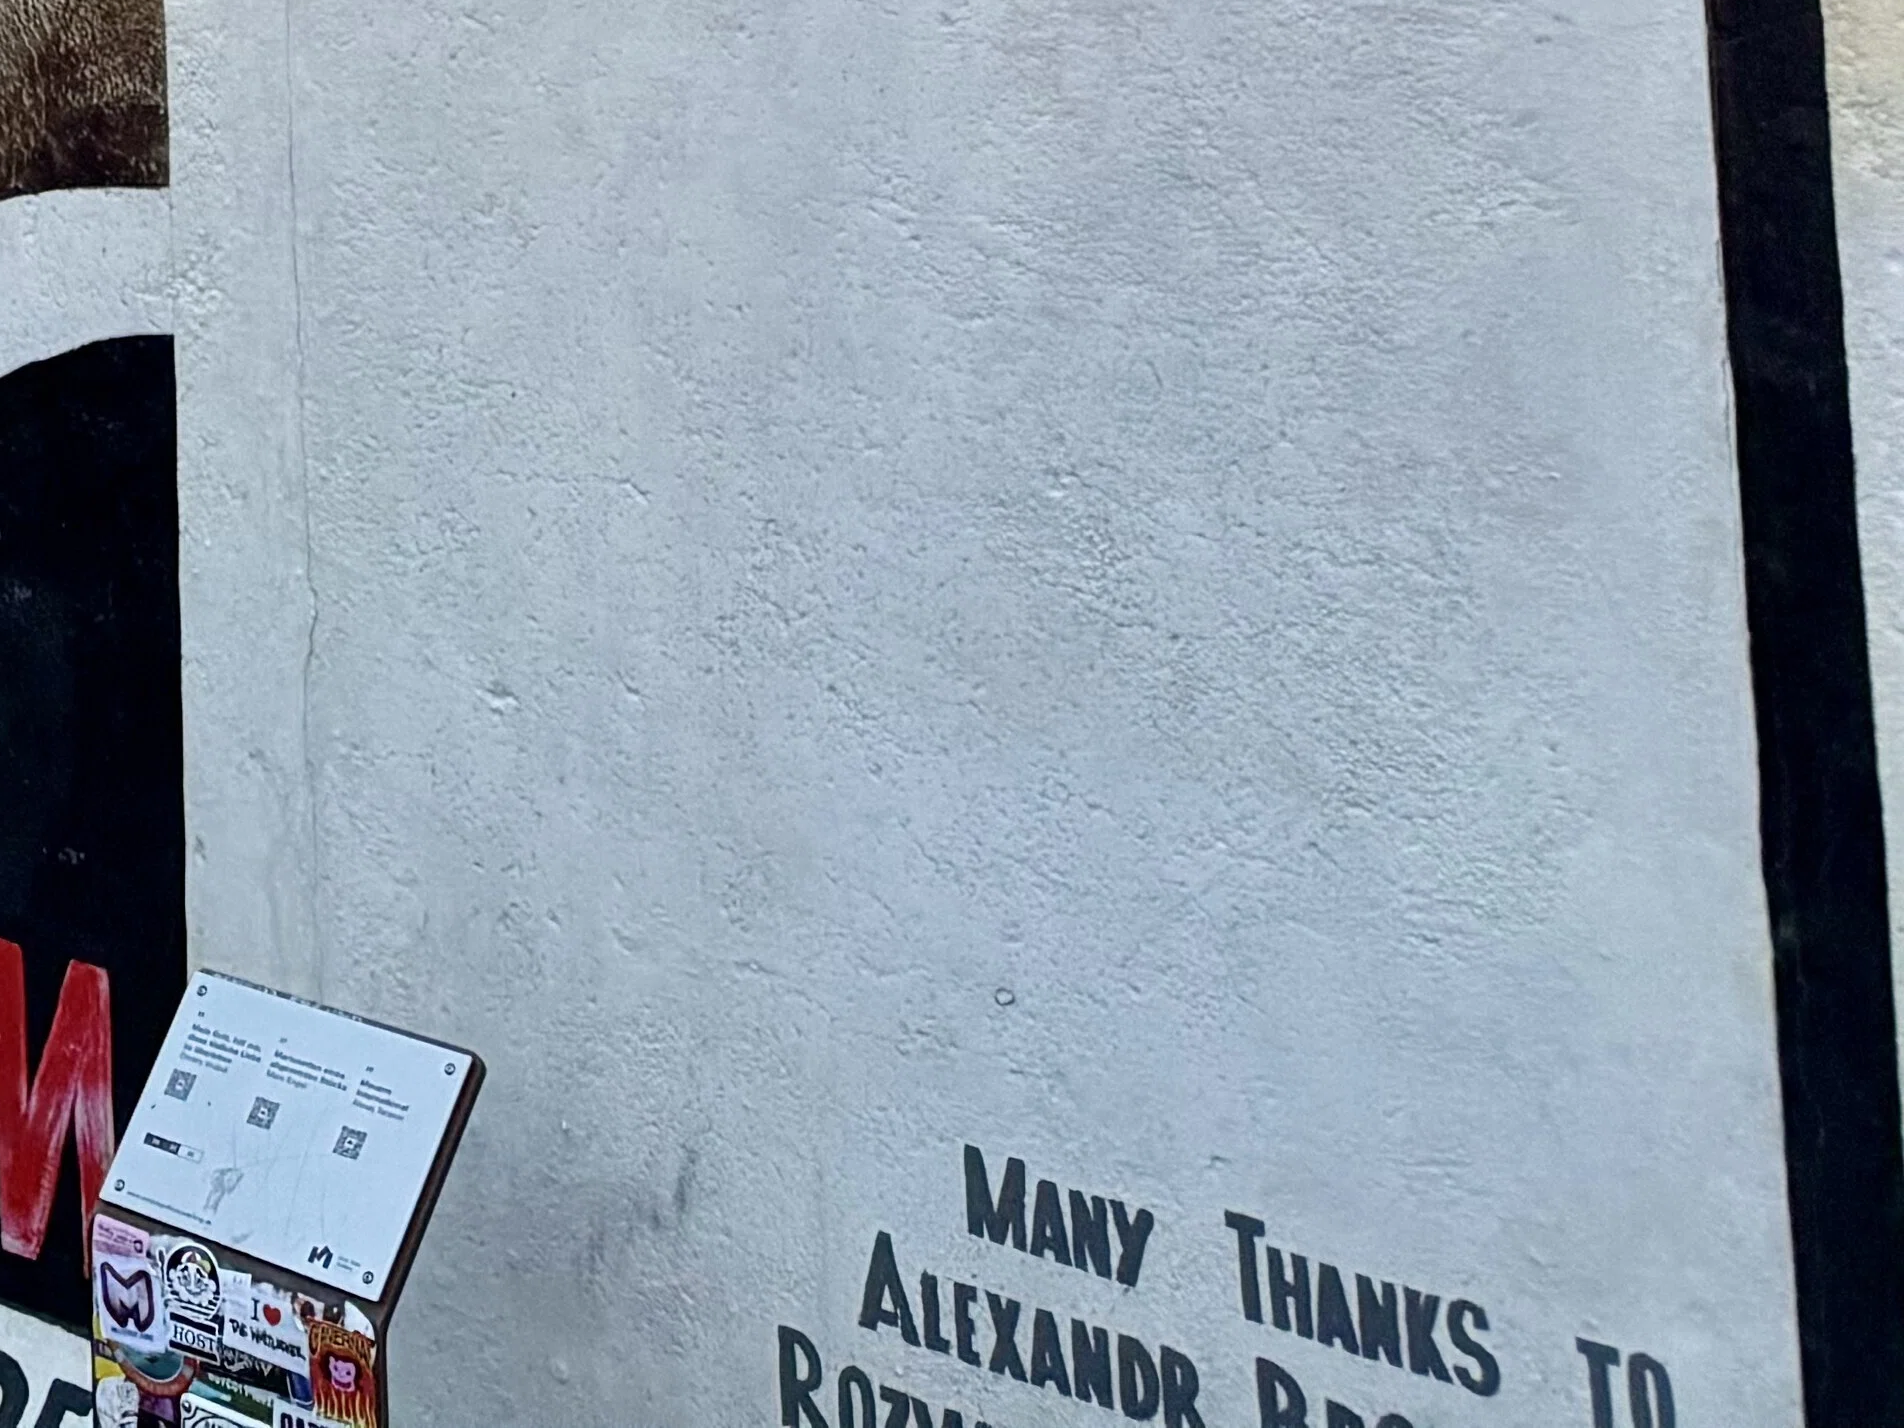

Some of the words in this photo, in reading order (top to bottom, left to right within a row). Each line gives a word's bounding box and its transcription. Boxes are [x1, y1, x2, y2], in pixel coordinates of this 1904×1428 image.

[172, 1321, 216, 1353] HOST
[250, 1297, 261, 1322] I
[858, 1228, 1208, 1428] ALEXANDR
[963, 1142, 1155, 1288] MANY
[1223, 1209, 1502, 1399] THANKS
[1574, 1335, 1678, 1428] TO
